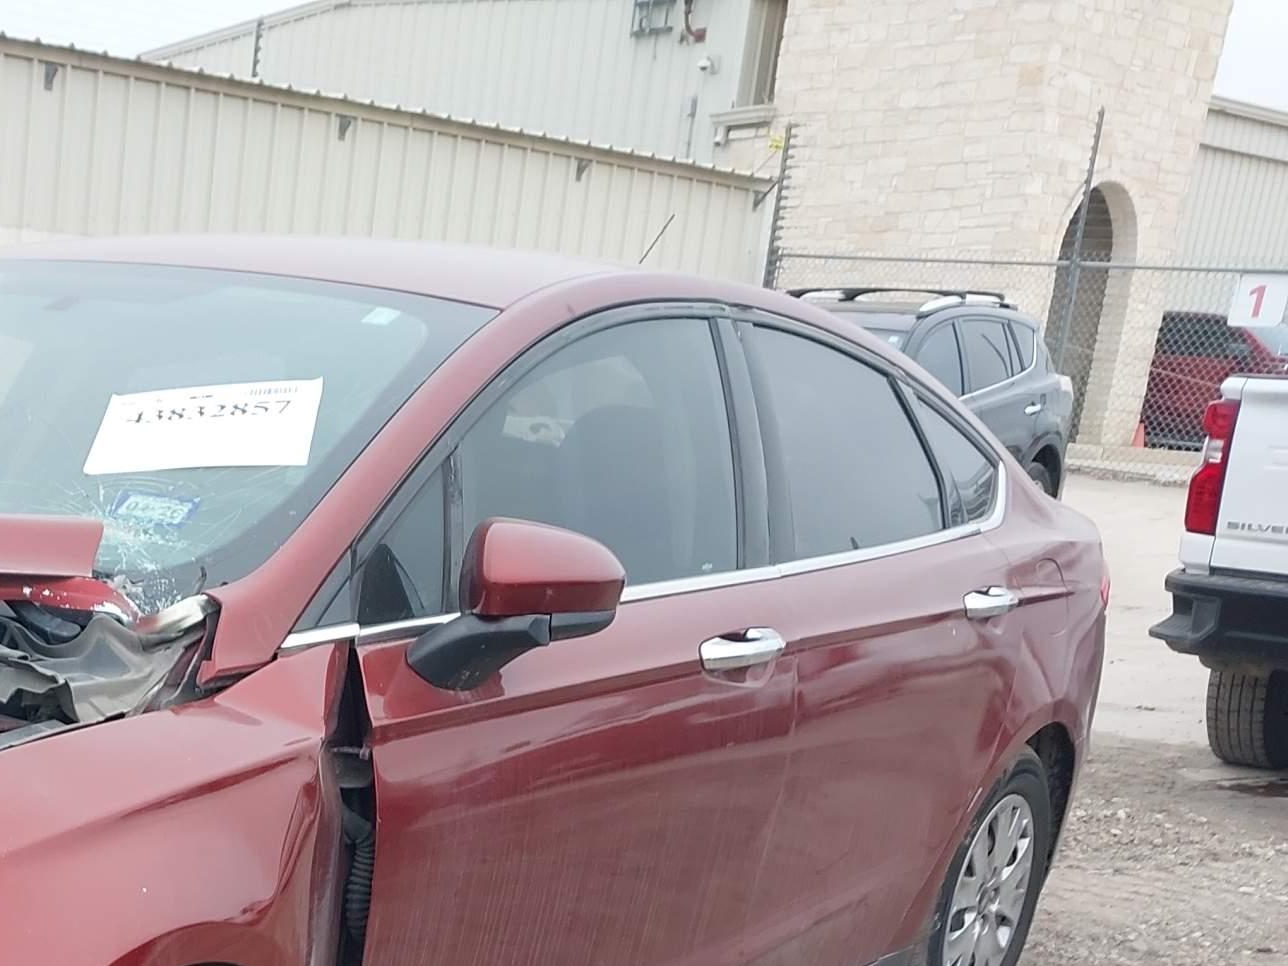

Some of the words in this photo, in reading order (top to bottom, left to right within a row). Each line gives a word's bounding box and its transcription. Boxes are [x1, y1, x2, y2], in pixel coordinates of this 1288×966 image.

[1248, 284, 1267, 319] 1
[126, 400, 292, 424] 43832857
[1226, 521, 1288, 535] SILVE
